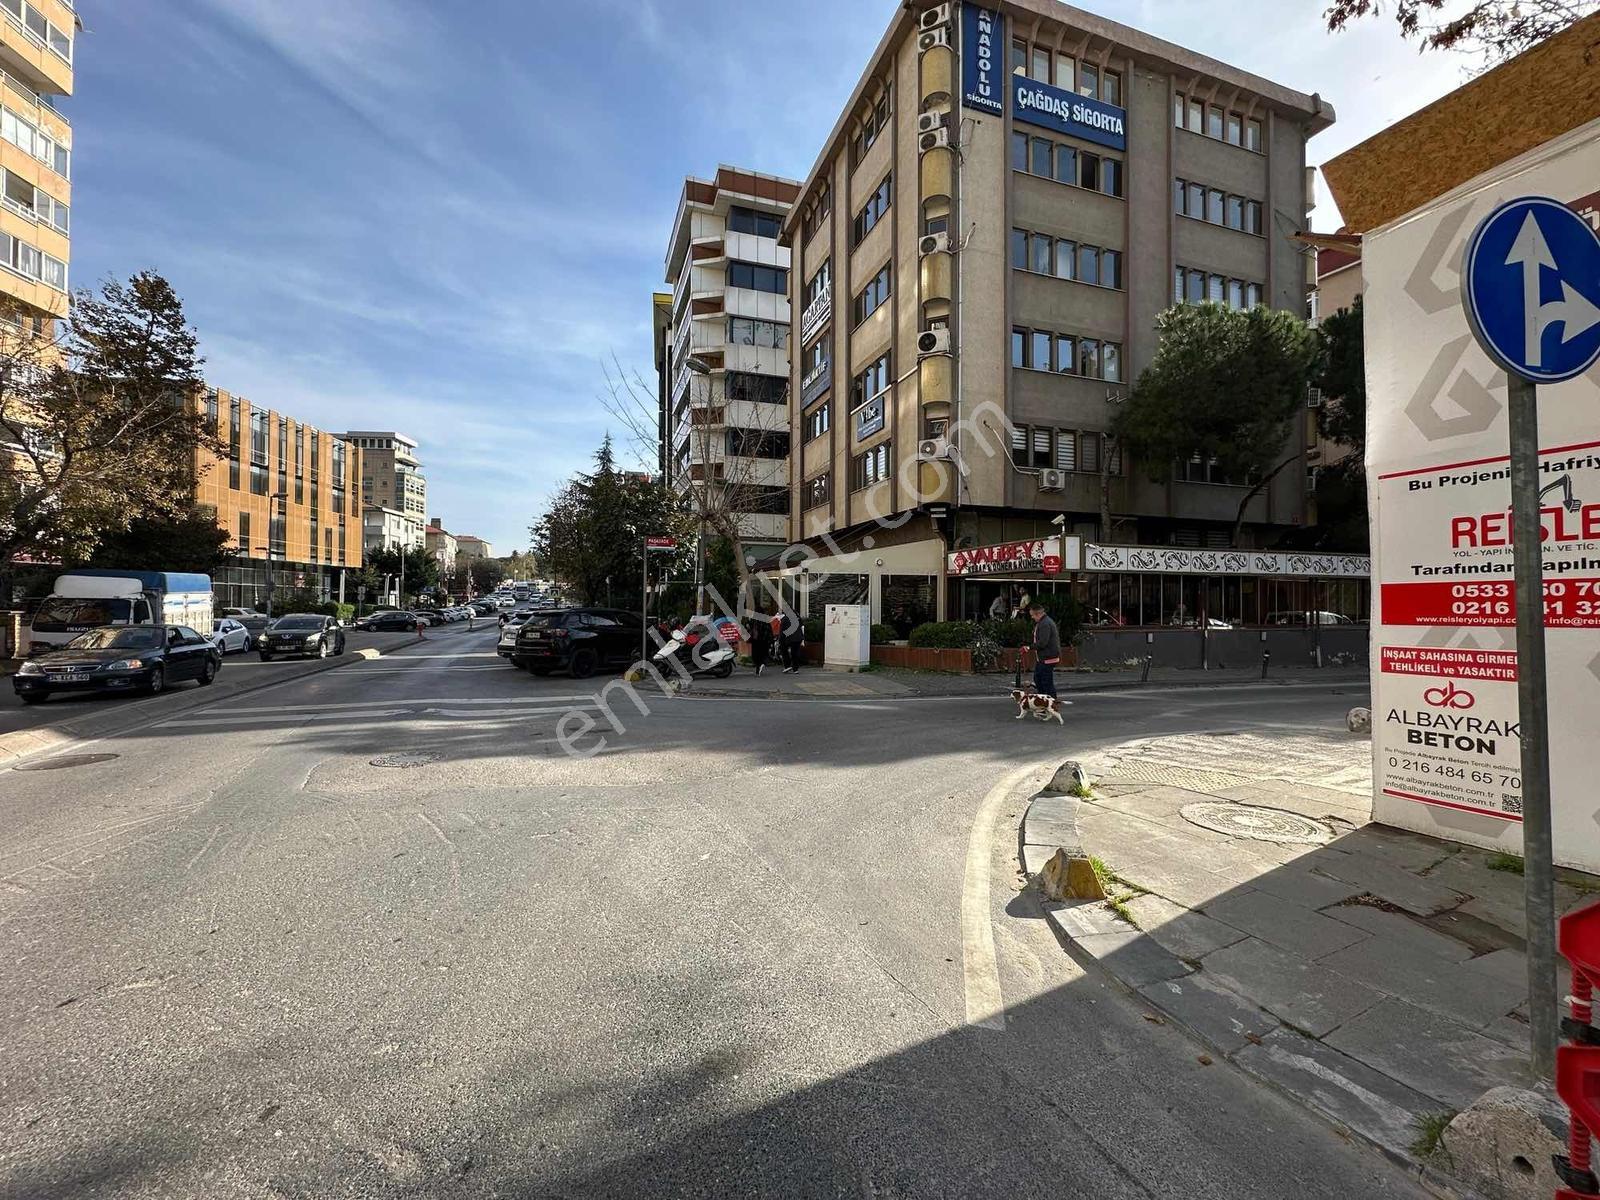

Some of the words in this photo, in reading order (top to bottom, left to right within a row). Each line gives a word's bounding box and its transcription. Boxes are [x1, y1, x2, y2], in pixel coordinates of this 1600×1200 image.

[978, 8, 991, 96] ANADOLU
[966, 92, 1002, 109] SİGORTA
[1017, 88, 1069, 122] ÇAĞDAŞ
[1073, 103, 1123, 135] SİGORTA
[1409, 480, 1432, 491] Bu
[1439, 467, 1511, 487] Projeni
[1576, 542, 1599, 550] TİC.
[1451, 584, 1509, 598] 0533
[1452, 601, 1509, 614] 0216
[1383, 648, 1417, 660] İNŞAAT
[1420, 652, 1473, 663] SAHASINA
[1390, 662, 1440, 674] TEHLİKELİ
[1457, 666, 1515, 679] YASAKTIR
[1386, 709, 1520, 738] ALBAYRAK
[1407, 729, 1495, 755] BETON
[1418, 752, 1447, 761] Albayrak
[1389, 757, 1398, 767] 0
[1402, 759, 1430, 773] 216
[1435, 765, 1465, 779] 484
[1471, 771, 1493, 784] 65
[1499, 775, 1520, 789] 70
[1385, 781, 1497, 807] info@albayrakbeton.com.tr
[1386, 773, 1494, 798] www.albayrakbeton.com.tr
